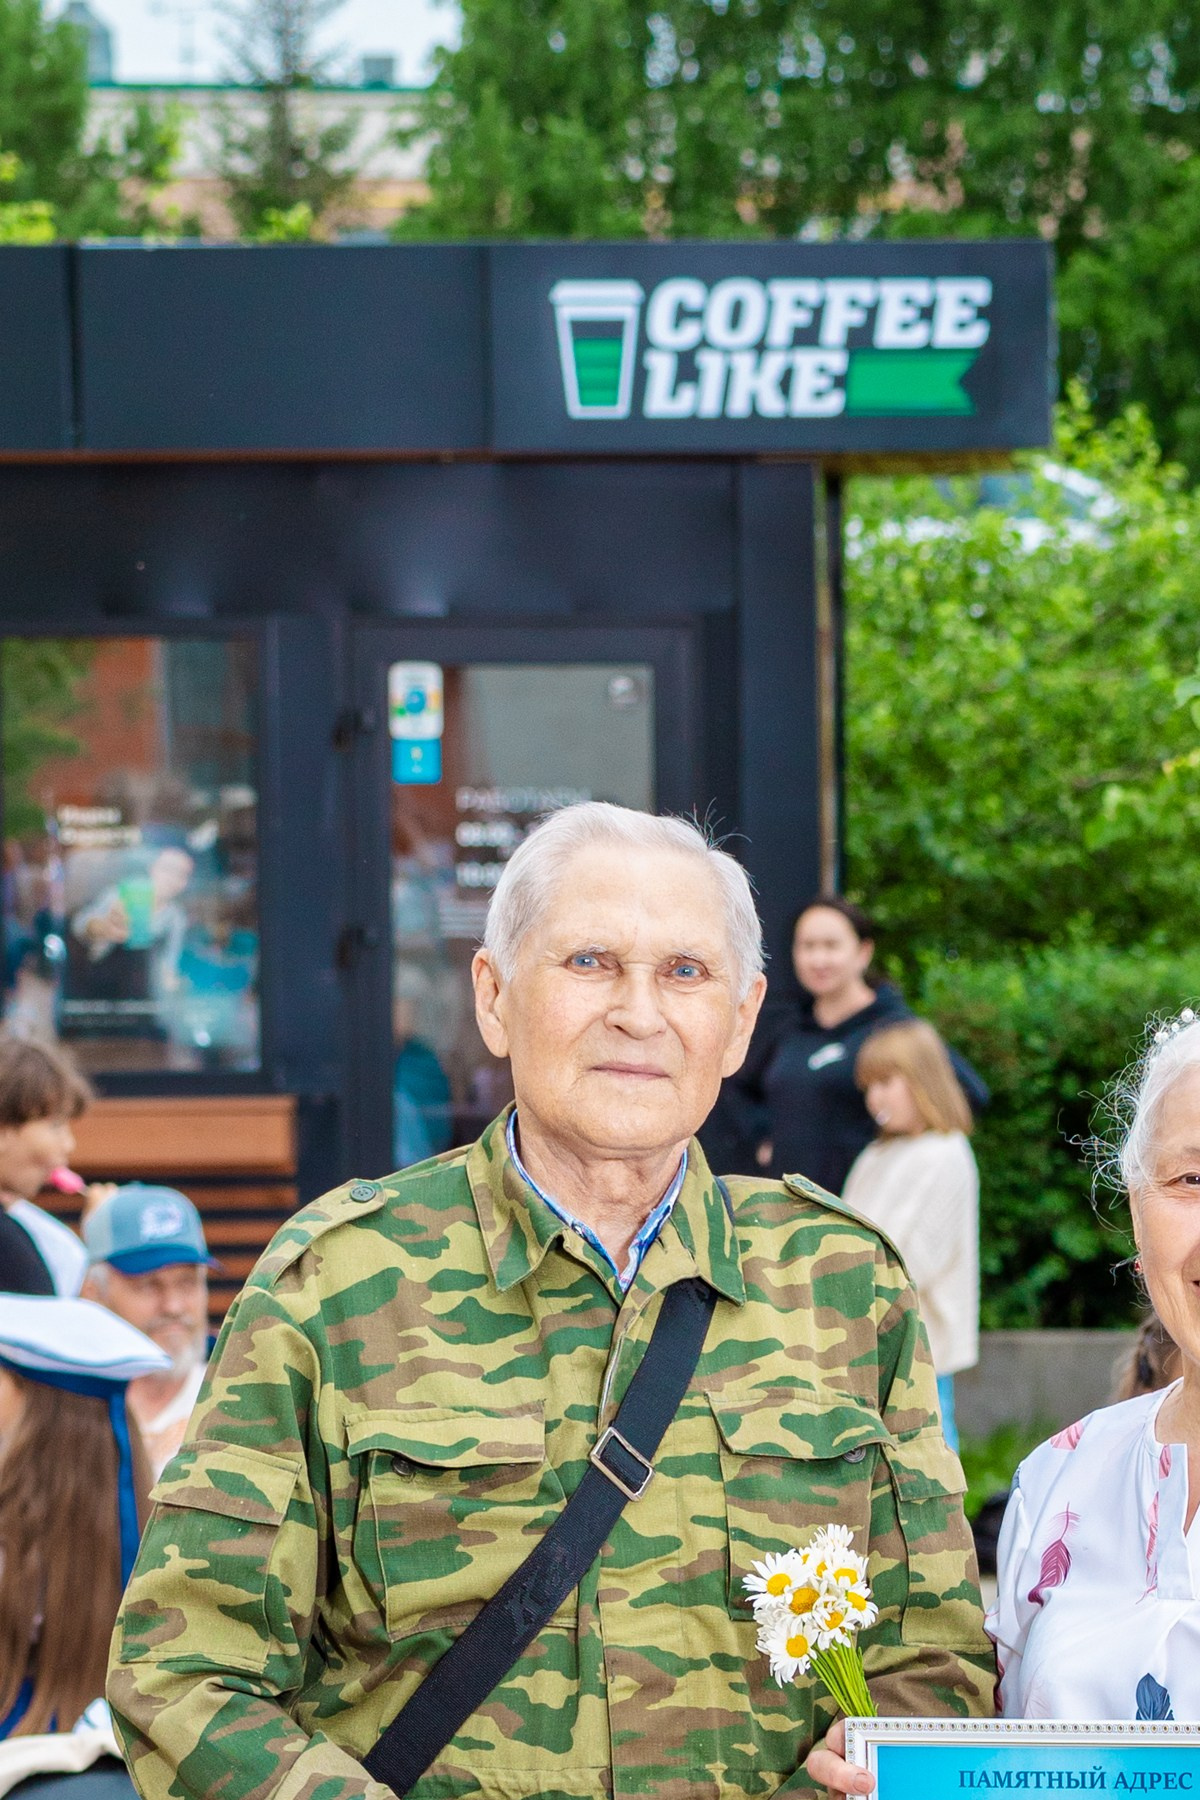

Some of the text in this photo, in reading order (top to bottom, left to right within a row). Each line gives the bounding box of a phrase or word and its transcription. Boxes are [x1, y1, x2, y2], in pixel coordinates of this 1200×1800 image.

[644, 276, 994, 352] COFFEE
[642, 347, 849, 419] LIKE
[959, 1766, 1193, 1793] ПАМЯТНЫЙ АДРЕС
